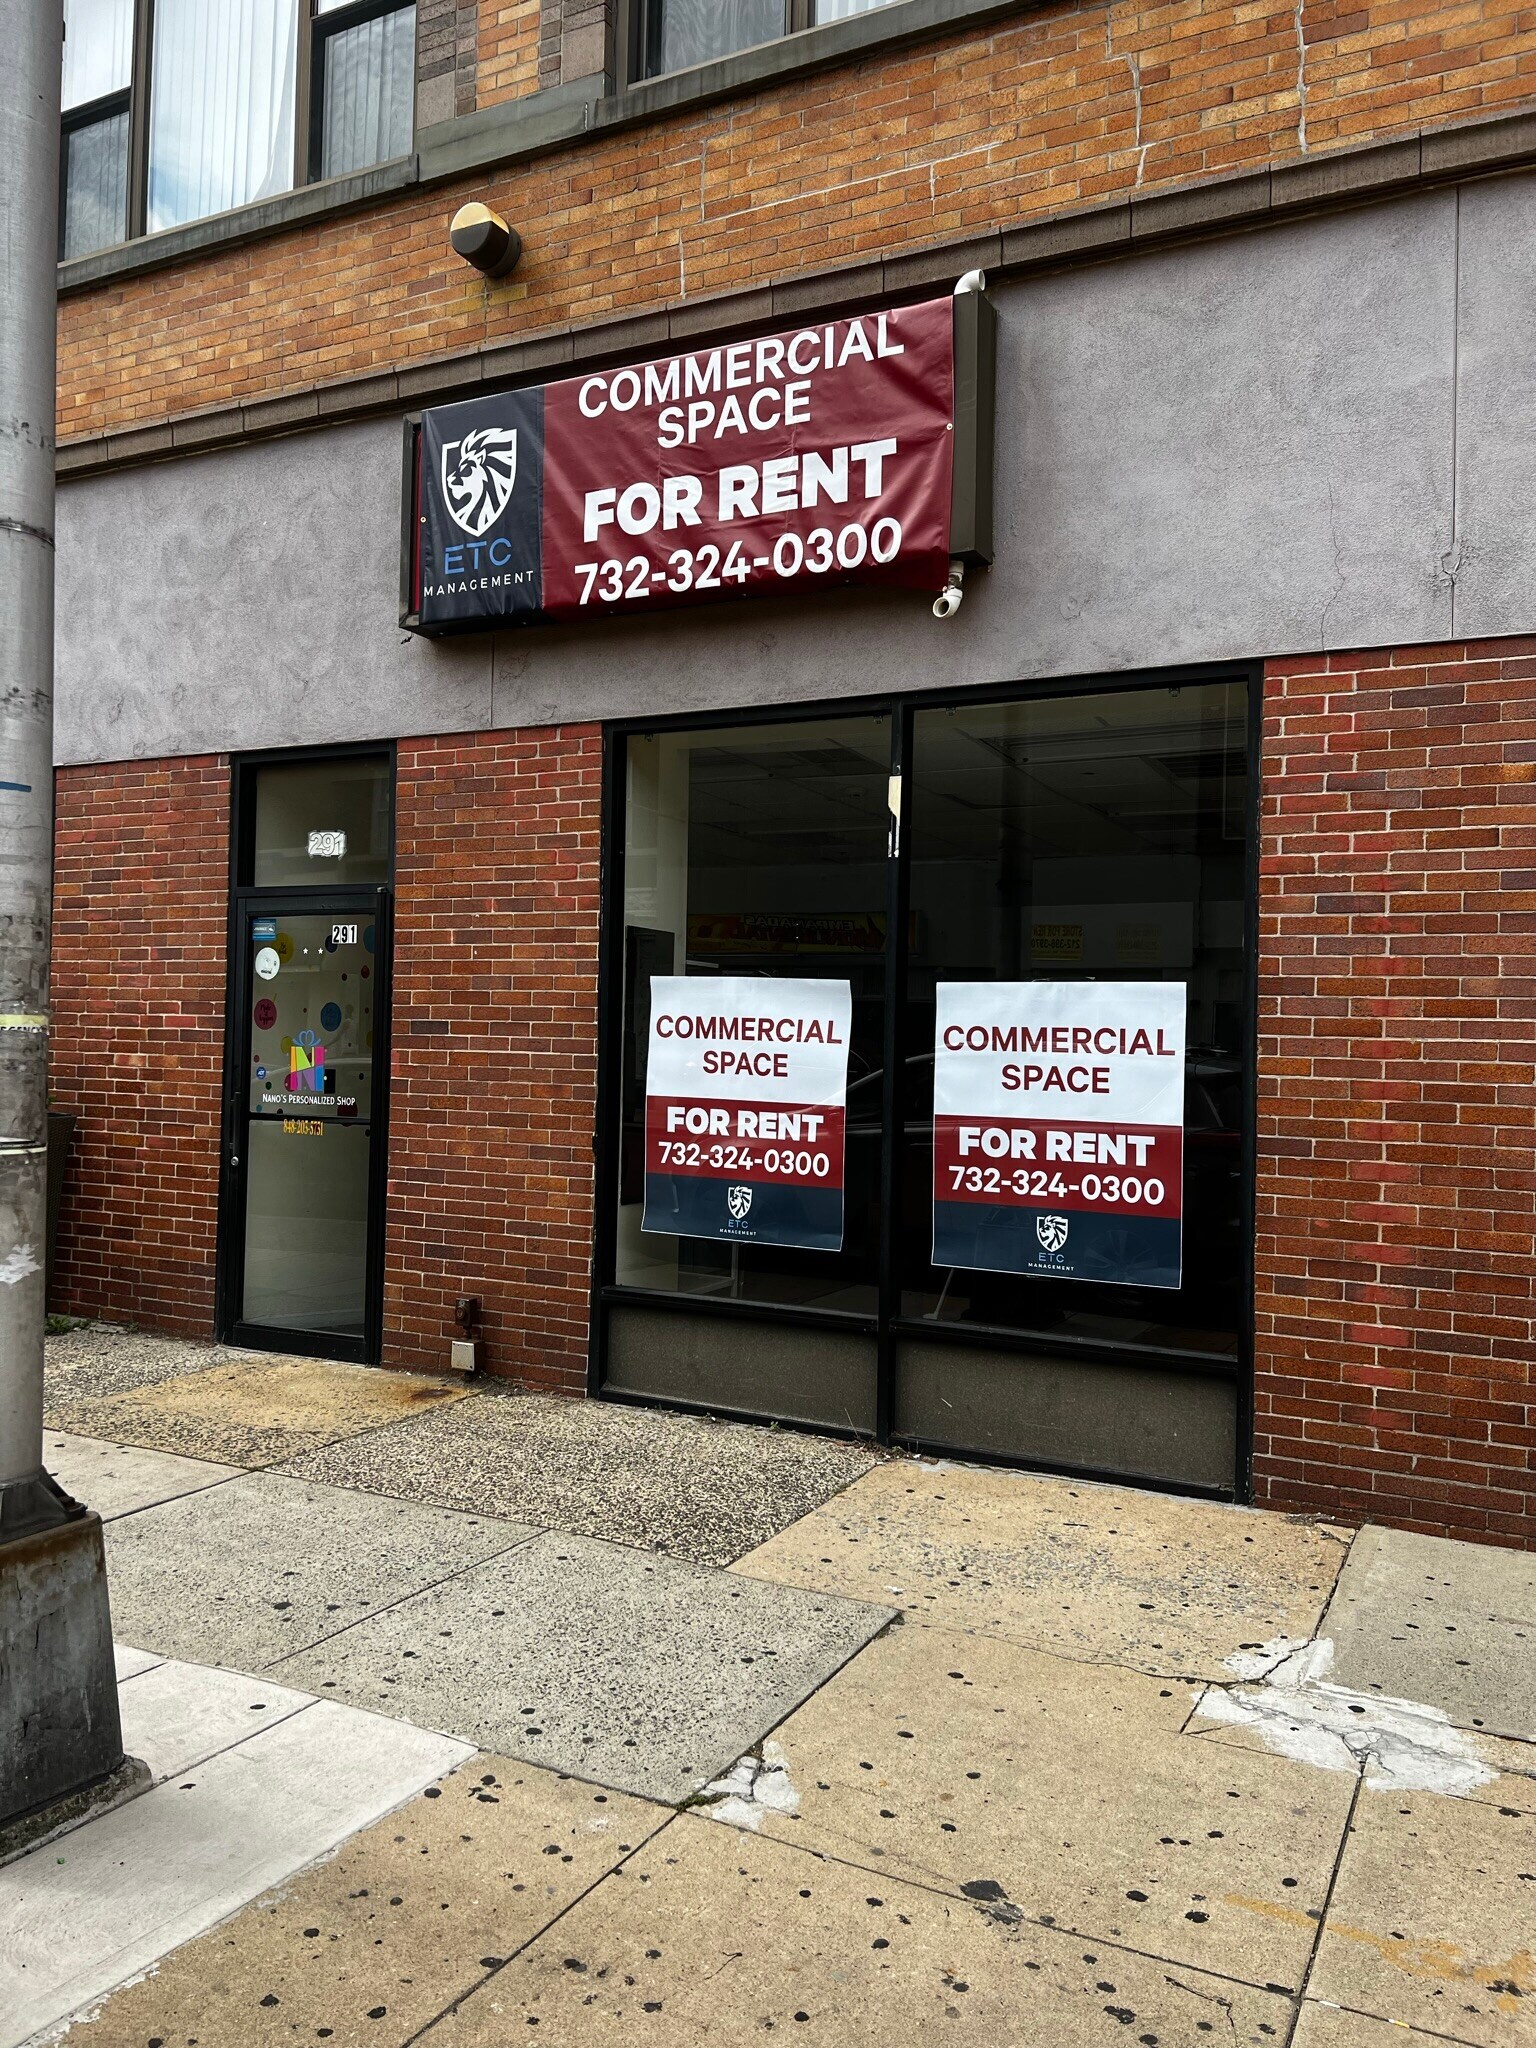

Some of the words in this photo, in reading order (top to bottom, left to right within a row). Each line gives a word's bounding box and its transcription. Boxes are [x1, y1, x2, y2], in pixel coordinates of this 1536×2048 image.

[578, 314, 904, 419] COMMERCIAL
[656, 379, 812, 449] SPACE
[583, 478, 702, 543] FOR
[717, 437, 898, 522] RENT
[444, 537, 512, 575] ETC
[573, 516, 902, 606] 732-324-0300
[423, 570, 534, 598] MANAGEMENT
[309, 832, 344, 856] 291
[333, 926, 355, 943] 291
[655, 1015, 842, 1044] COMMERCIAL
[943, 1025, 1176, 1056] COMMERCIAL
[702, 1051, 788, 1077] SPACE
[1001, 1064, 1110, 1094] SPACE
[666, 1106, 732, 1136] FOR
[736, 1111, 824, 1143] RENT
[658, 1141, 829, 1177] 732-324-0300
[958, 1126, 1036, 1160] FOR
[1045, 1131, 1156, 1167] RENT
[948, 1165, 1165, 1206] 732-324-0300
[719, 1228, 757, 1236] MANAGEMENT
[728, 1219, 749, 1228] ETC
[1028, 1262, 1075, 1271] MANAGEMENT
[1038, 1252, 1065, 1263] ETC
